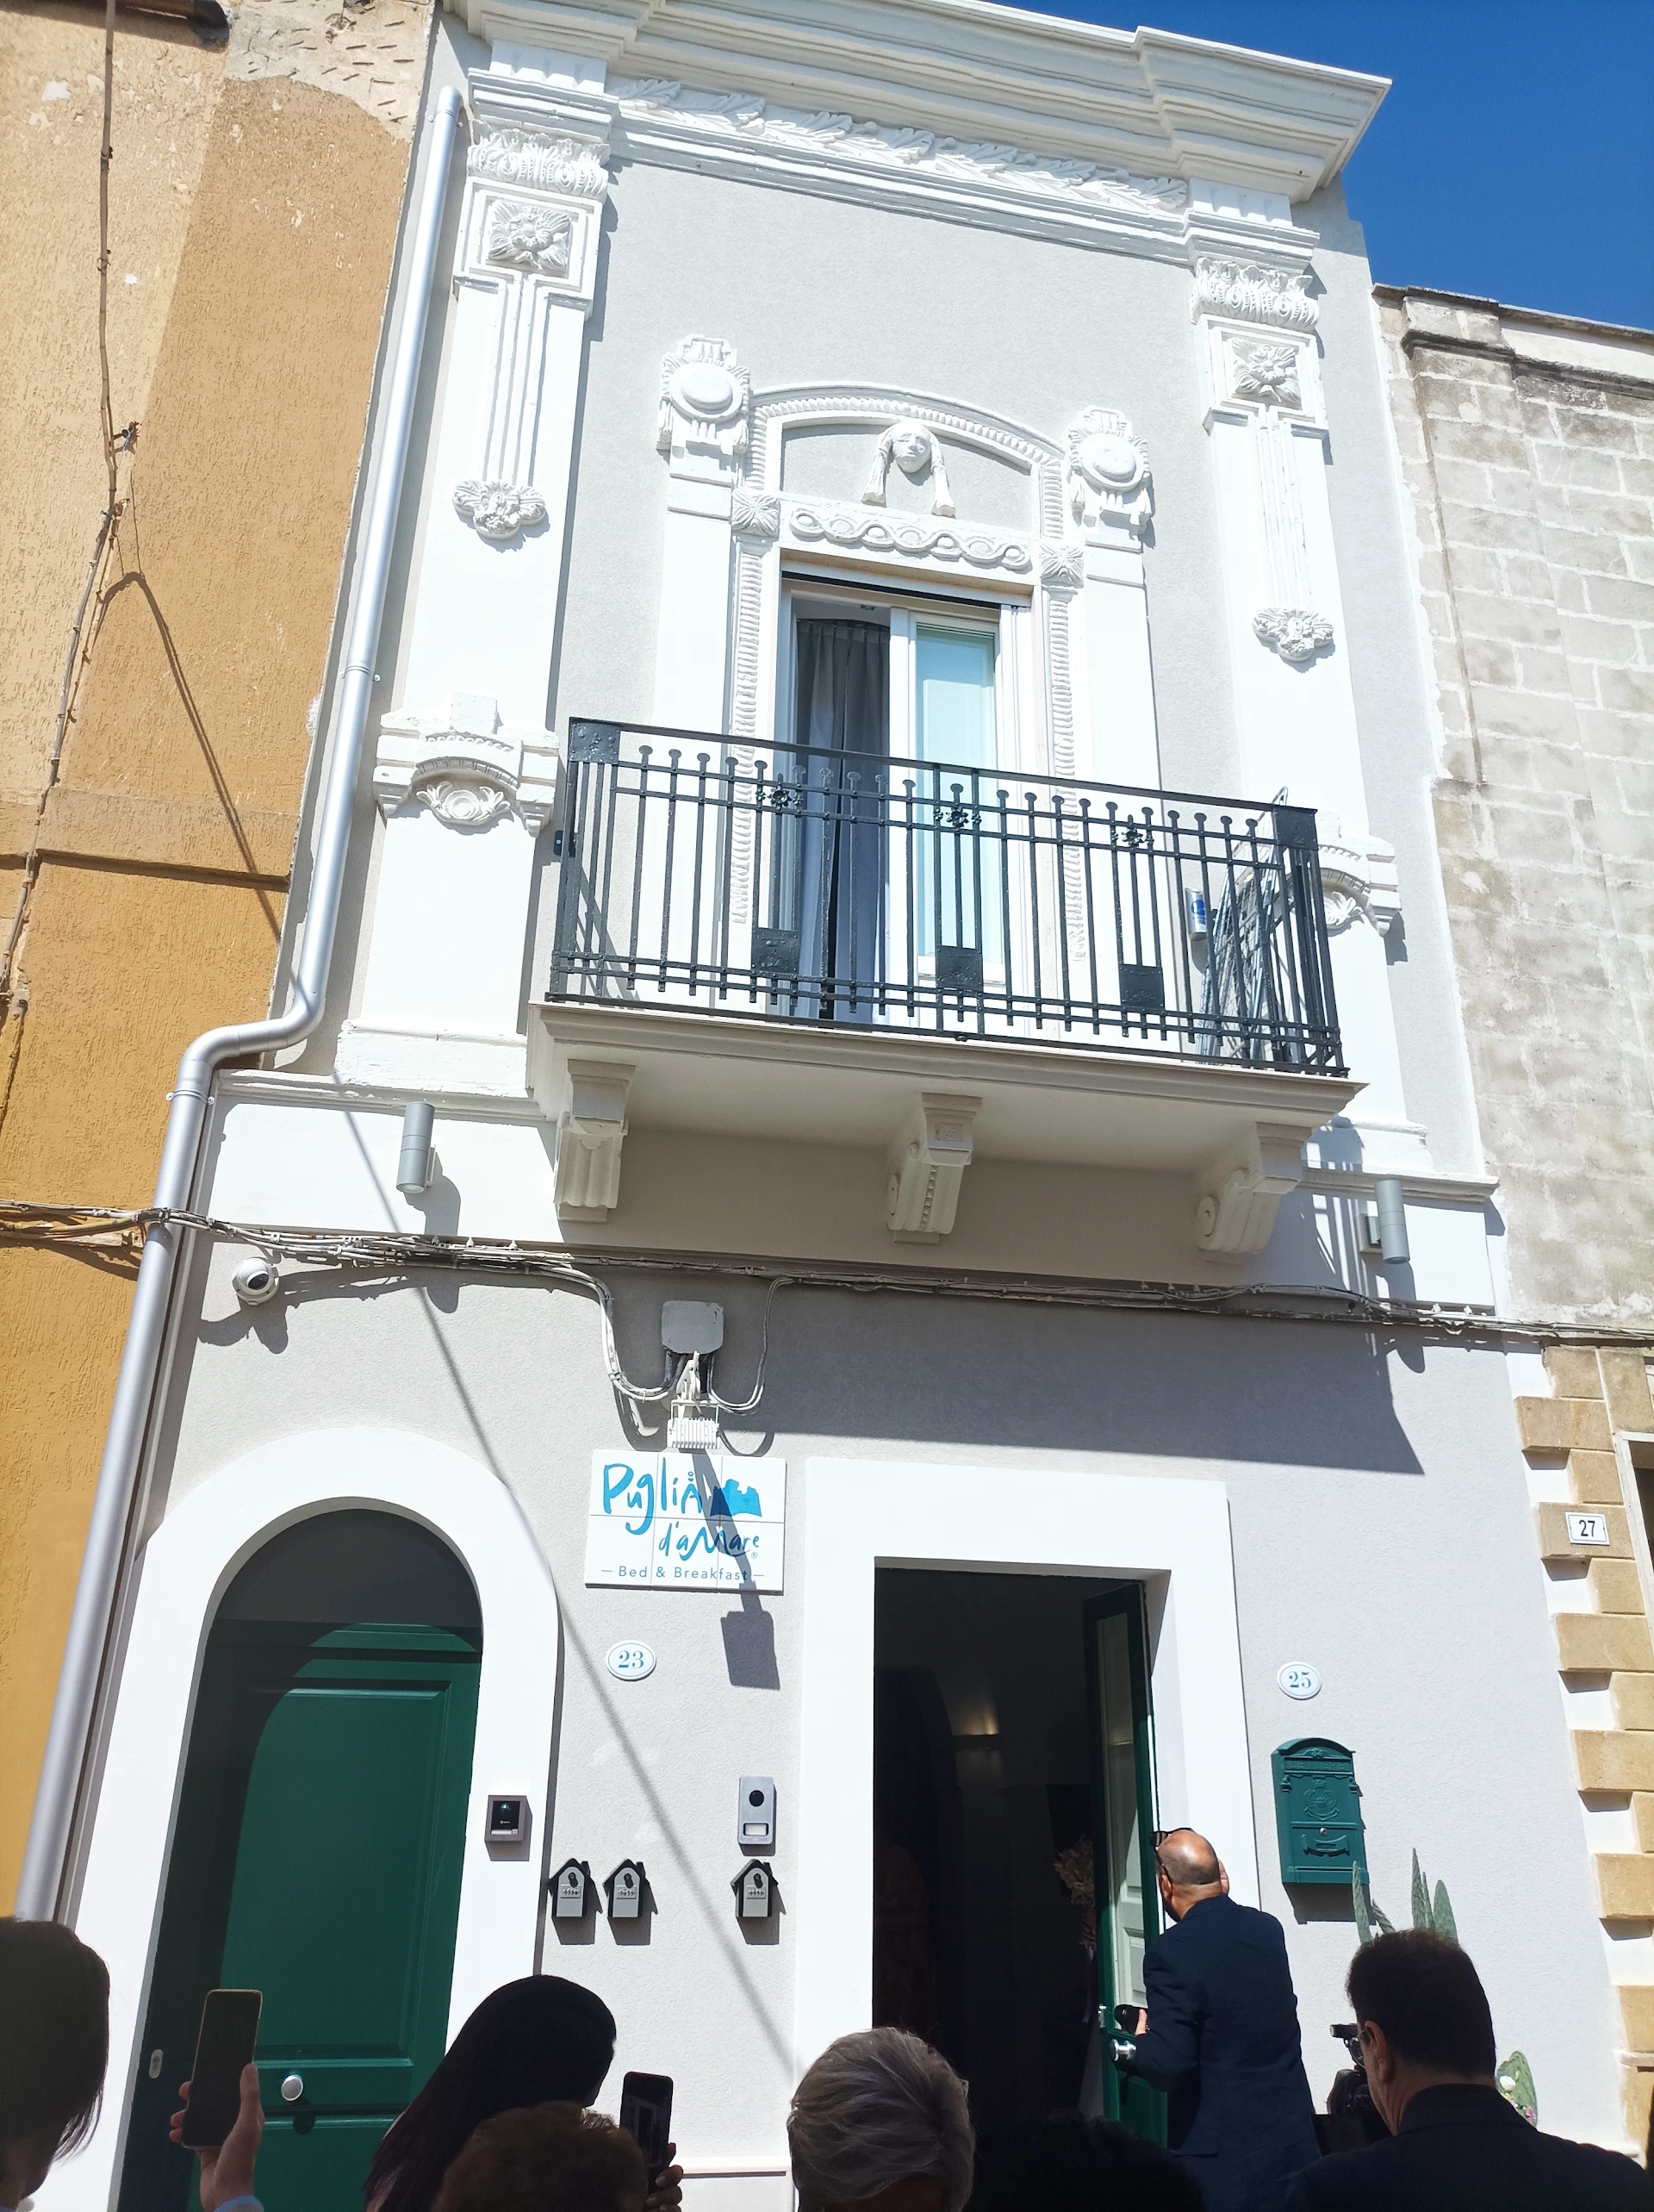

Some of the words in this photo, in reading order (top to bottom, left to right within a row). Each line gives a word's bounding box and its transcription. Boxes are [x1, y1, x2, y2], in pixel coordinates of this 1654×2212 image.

[1578, 1519, 1595, 1537] 27
[619, 1565, 648, 1578] Bed
[656, 1566, 666, 1579] &
[674, 1566, 749, 1581] Breakfast
[618, 1649, 644, 1669] 23
[1289, 1670, 1312, 1689] 25
